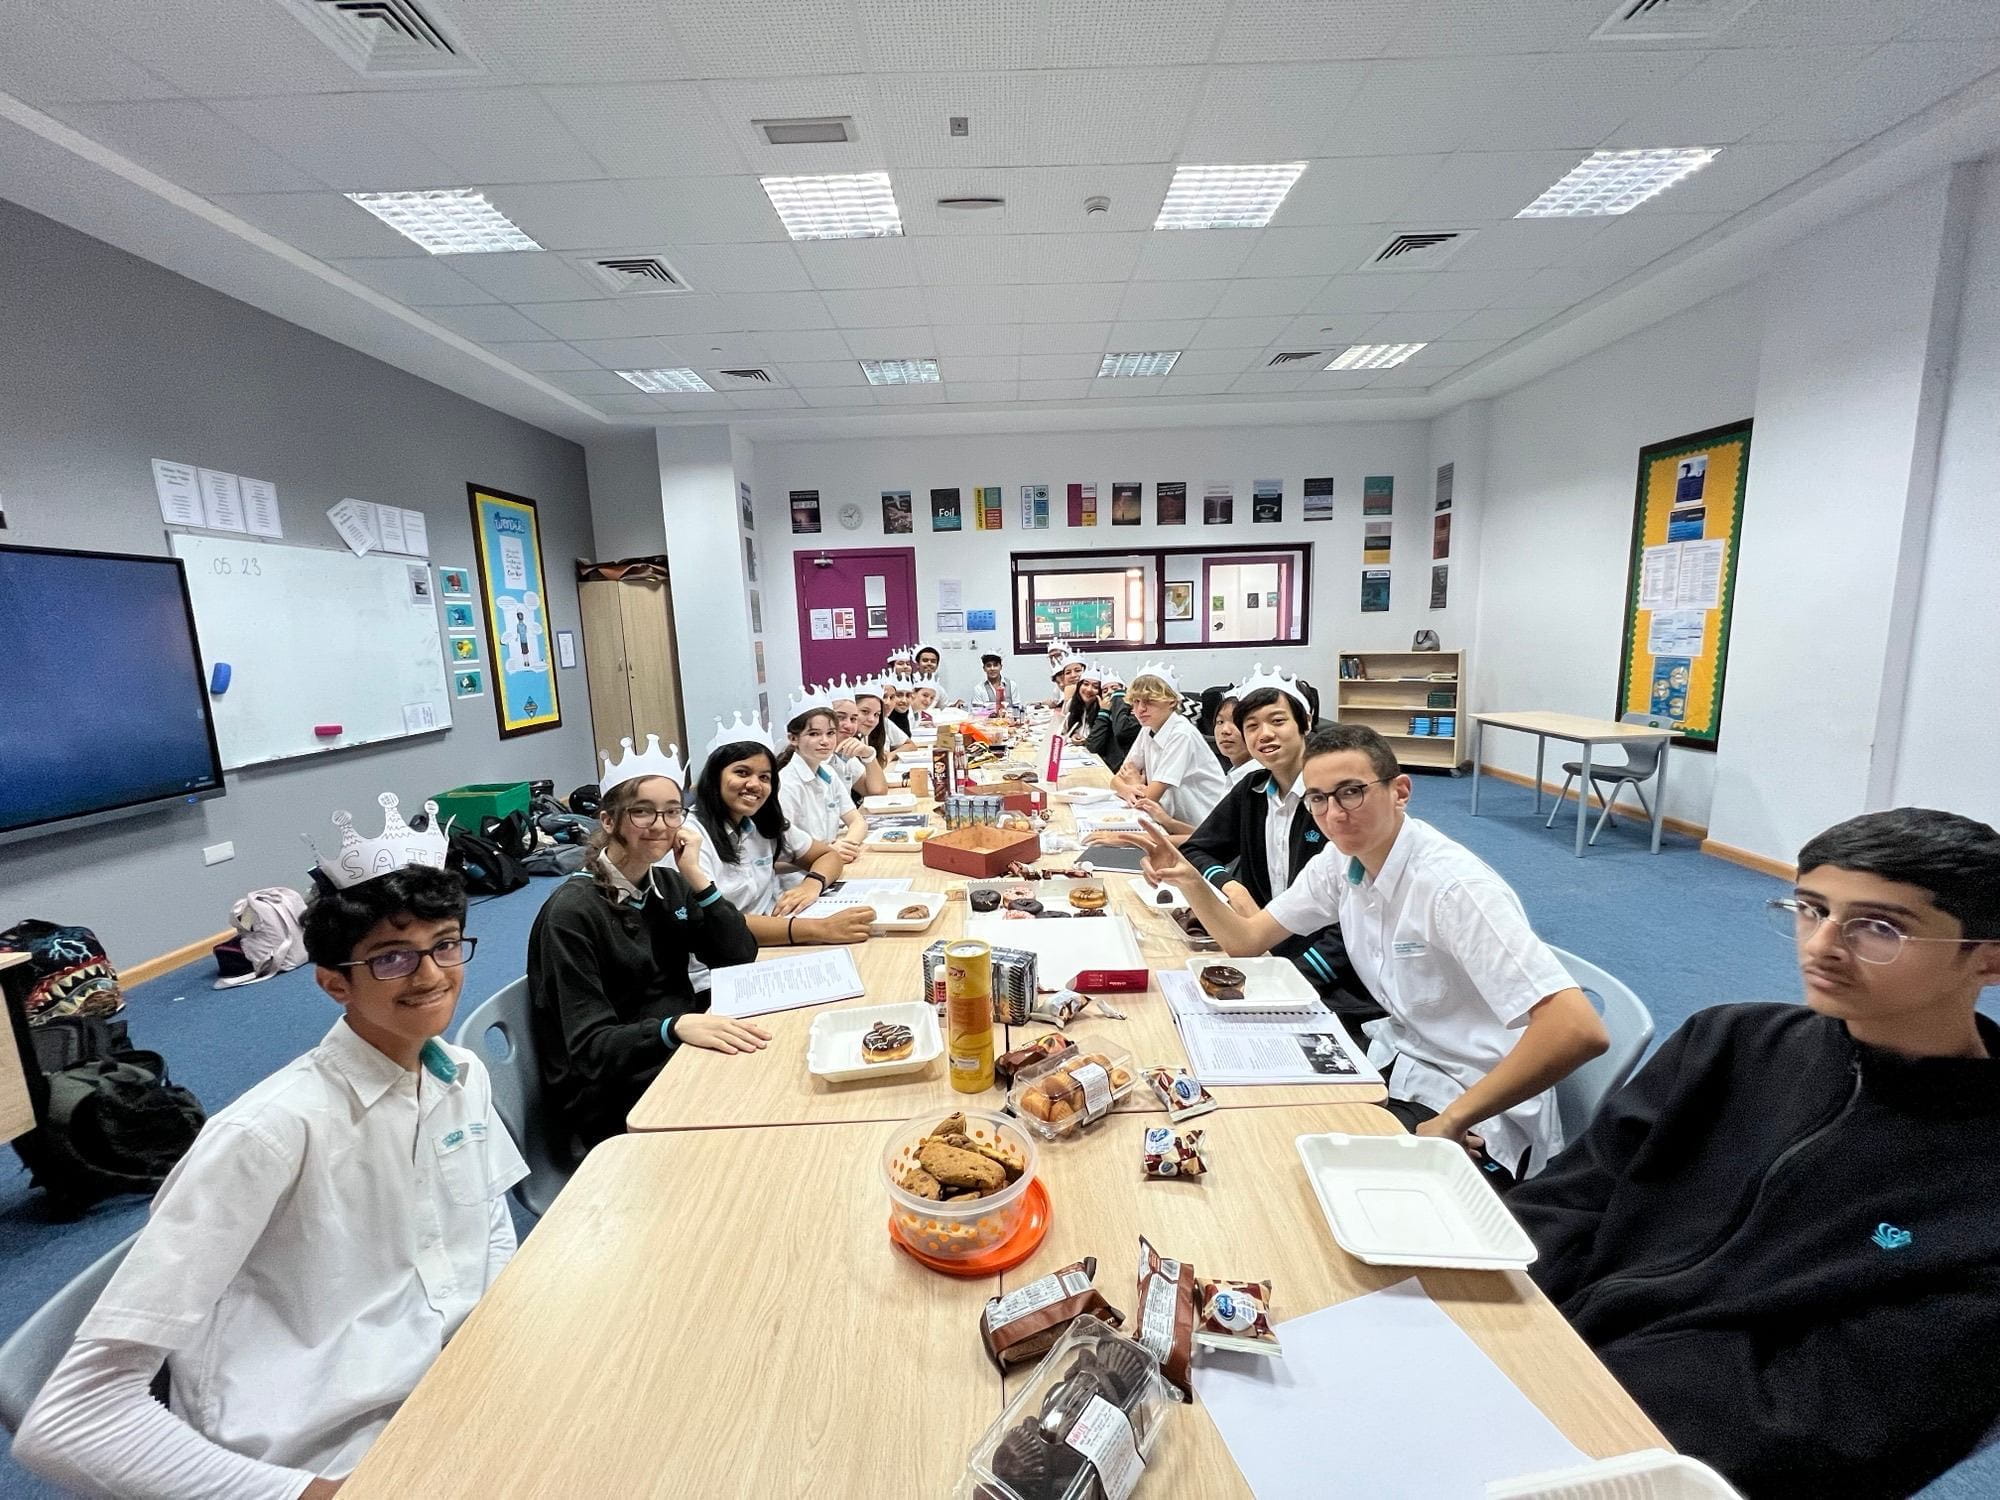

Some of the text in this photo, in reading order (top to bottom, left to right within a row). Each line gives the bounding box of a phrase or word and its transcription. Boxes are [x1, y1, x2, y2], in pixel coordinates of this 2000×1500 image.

[939, 507, 954, 518] Foil
[1024, 488, 1032, 527] IMAGERY
[242, 557, 262, 576] 23
